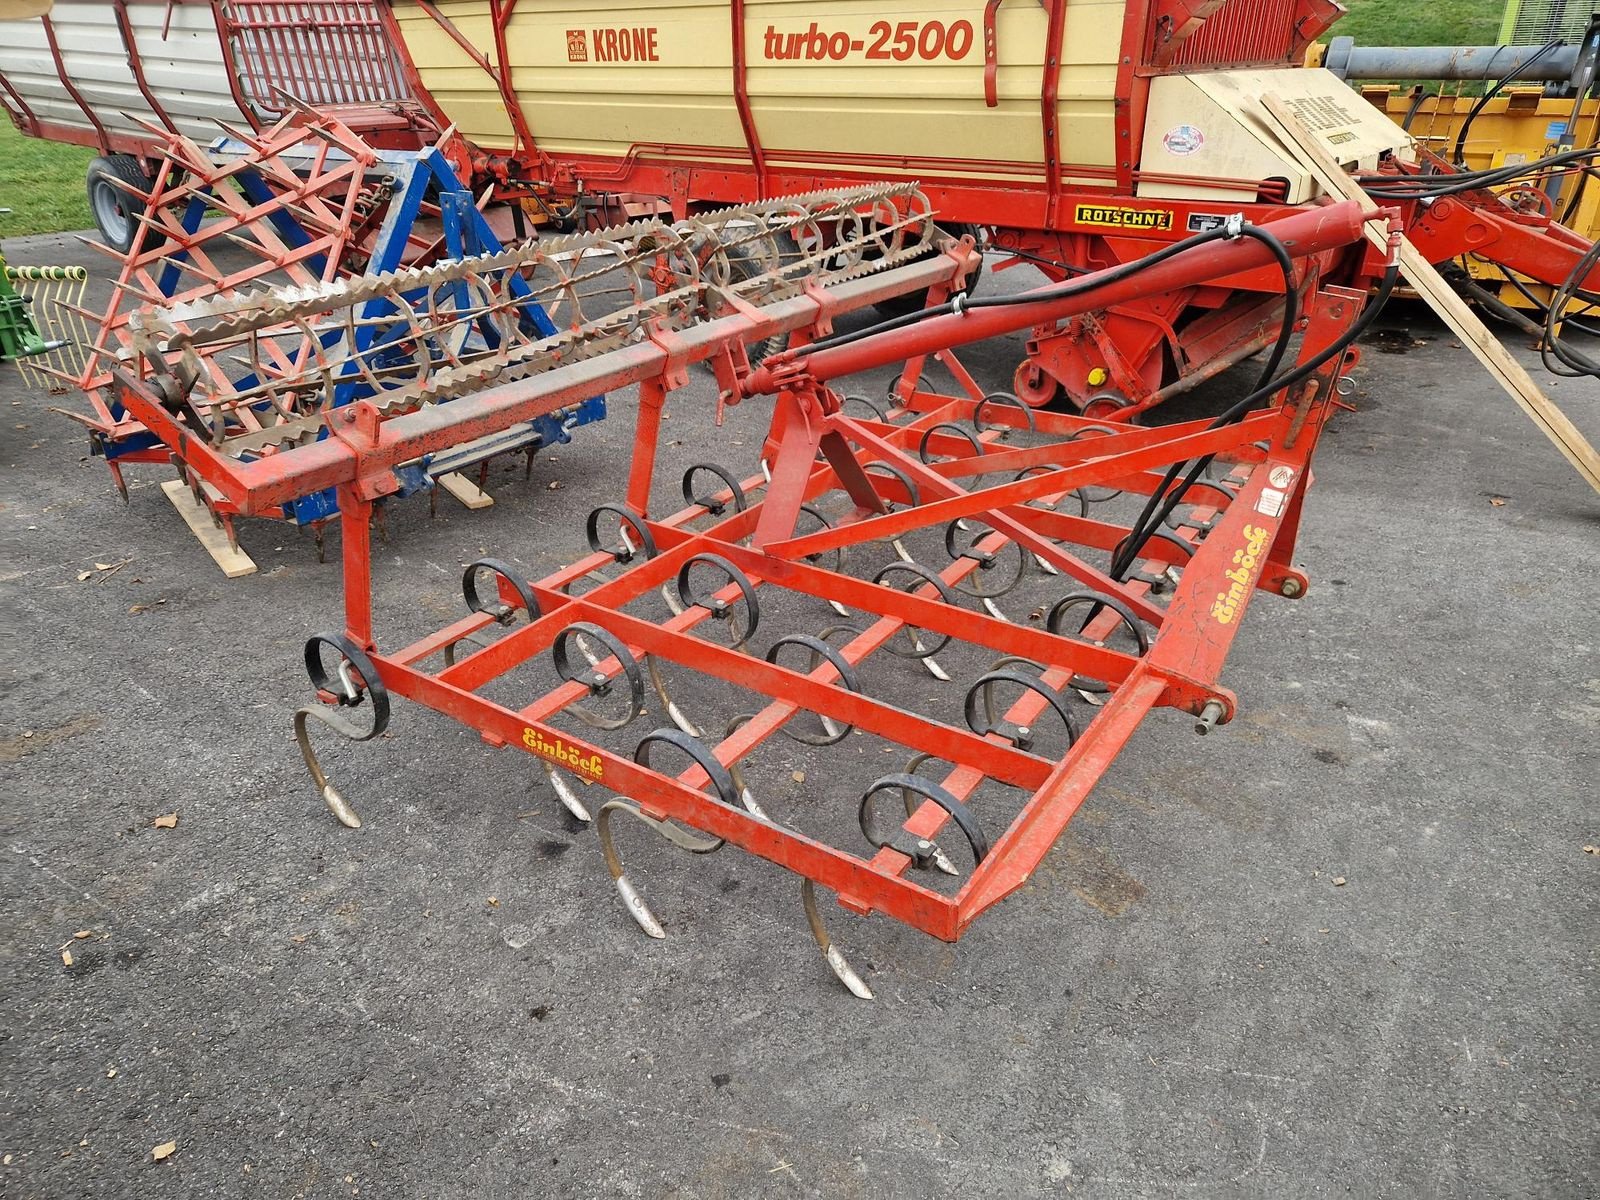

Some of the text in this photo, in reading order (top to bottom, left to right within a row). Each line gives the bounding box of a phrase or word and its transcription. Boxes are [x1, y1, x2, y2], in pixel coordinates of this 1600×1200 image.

[592, 27, 659, 62] KRONE
[764, 19, 974, 61] turbo-2500
[1211, 524, 1267, 624] Einböck
[522, 727, 603, 776] Einböck
